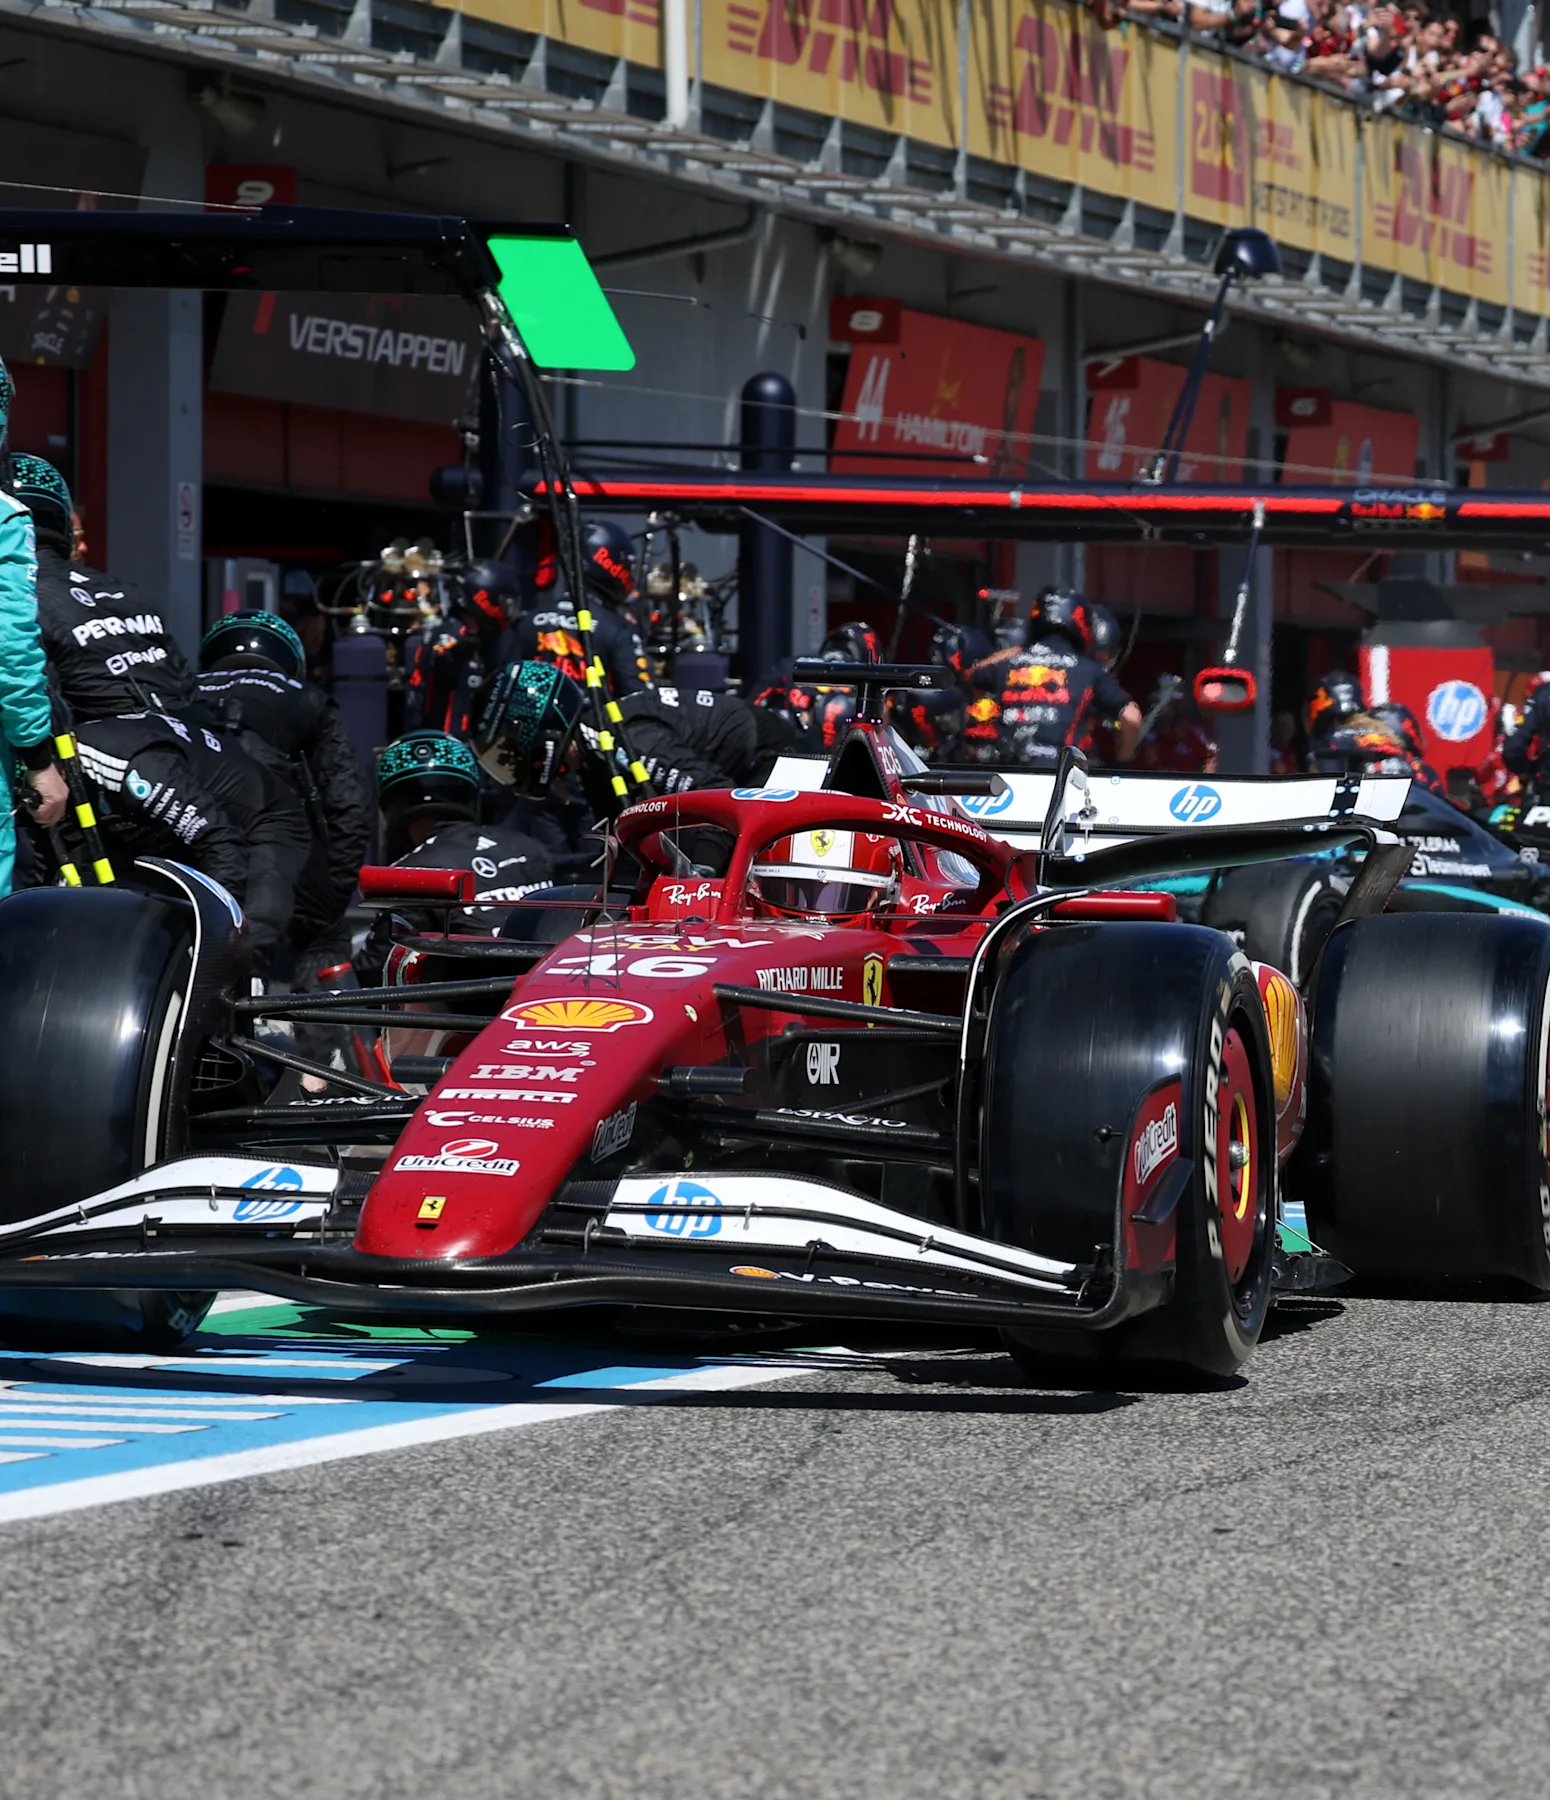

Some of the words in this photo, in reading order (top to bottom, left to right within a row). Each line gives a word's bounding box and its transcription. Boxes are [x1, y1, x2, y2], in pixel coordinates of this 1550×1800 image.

[1014, 15, 1132, 164] DHL
[1394, 143, 1478, 270] DHL
[289, 313, 467, 375] VERSTAPPEN
[856, 355, 891, 442] 44
[895, 411, 987, 453] HAMILTON
[1434, 681, 1481, 740] hp
[1173, 784, 1218, 823] hp
[925, 813, 988, 843] TECHNOLOGY
[911, 893, 967, 915] Ray-Ban
[573, 933, 774, 949] VGW
[597, 942, 716, 952] PLAY
[545, 953, 719, 979] 16
[756, 968, 809, 992] RICHARD
[810, 966, 844, 990] MILLE
[506, 1039, 593, 1052] aws
[469, 1064, 585, 1083] IBM
[437, 1088, 579, 1104] PIRELLI
[1203, 1014, 1225, 1208] ZERO
[467, 1114, 555, 1128] CELSIUS
[399, 1156, 516, 1173] UniCredit
[238, 1167, 301, 1219] hp
[653, 1178, 723, 1238] hp
[1208, 1216, 1223, 1261] P
